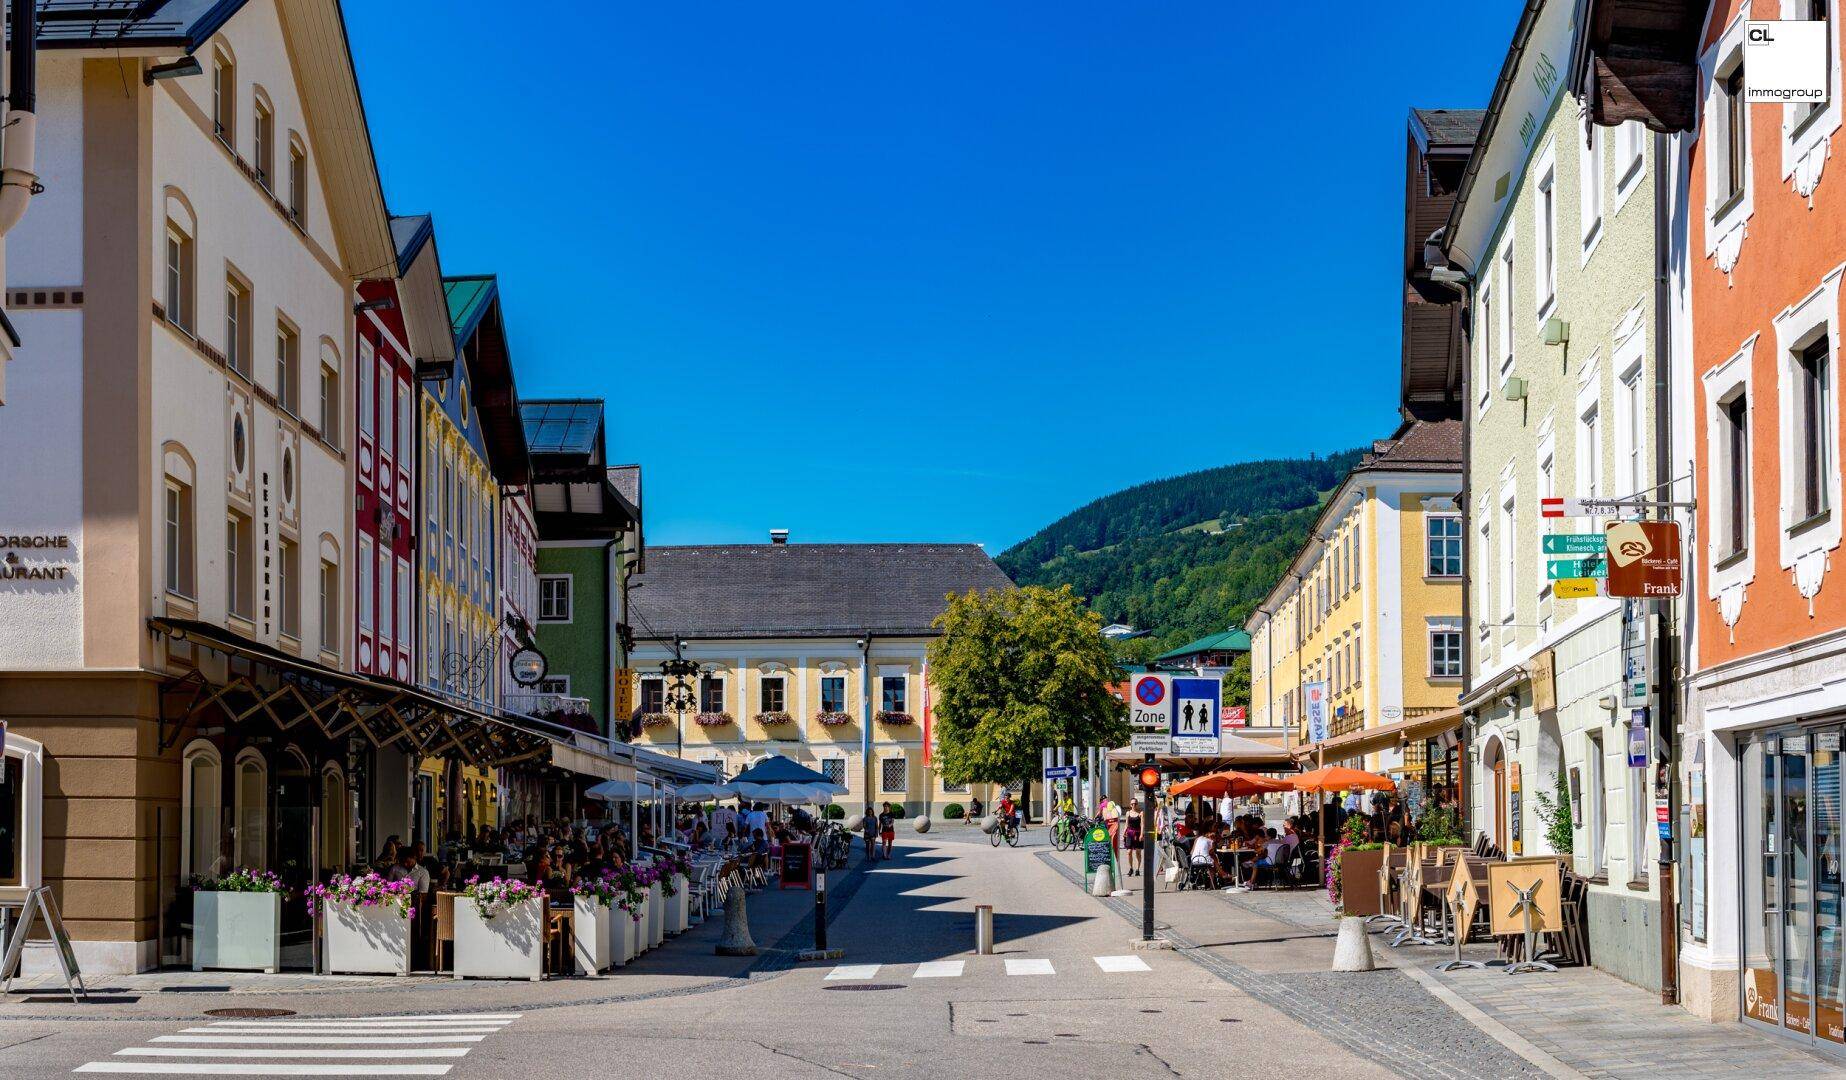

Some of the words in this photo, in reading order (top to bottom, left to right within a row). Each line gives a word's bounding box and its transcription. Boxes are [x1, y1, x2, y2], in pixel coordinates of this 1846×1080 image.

[6, 551, 19, 564] &
[0, 567, 67, 580] URANT
[1643, 582, 1679, 595] Frank
[619, 669, 628, 713] HOTEL
[1134, 709, 1166, 723] Zone
[1758, 996, 1779, 1021] Frank
